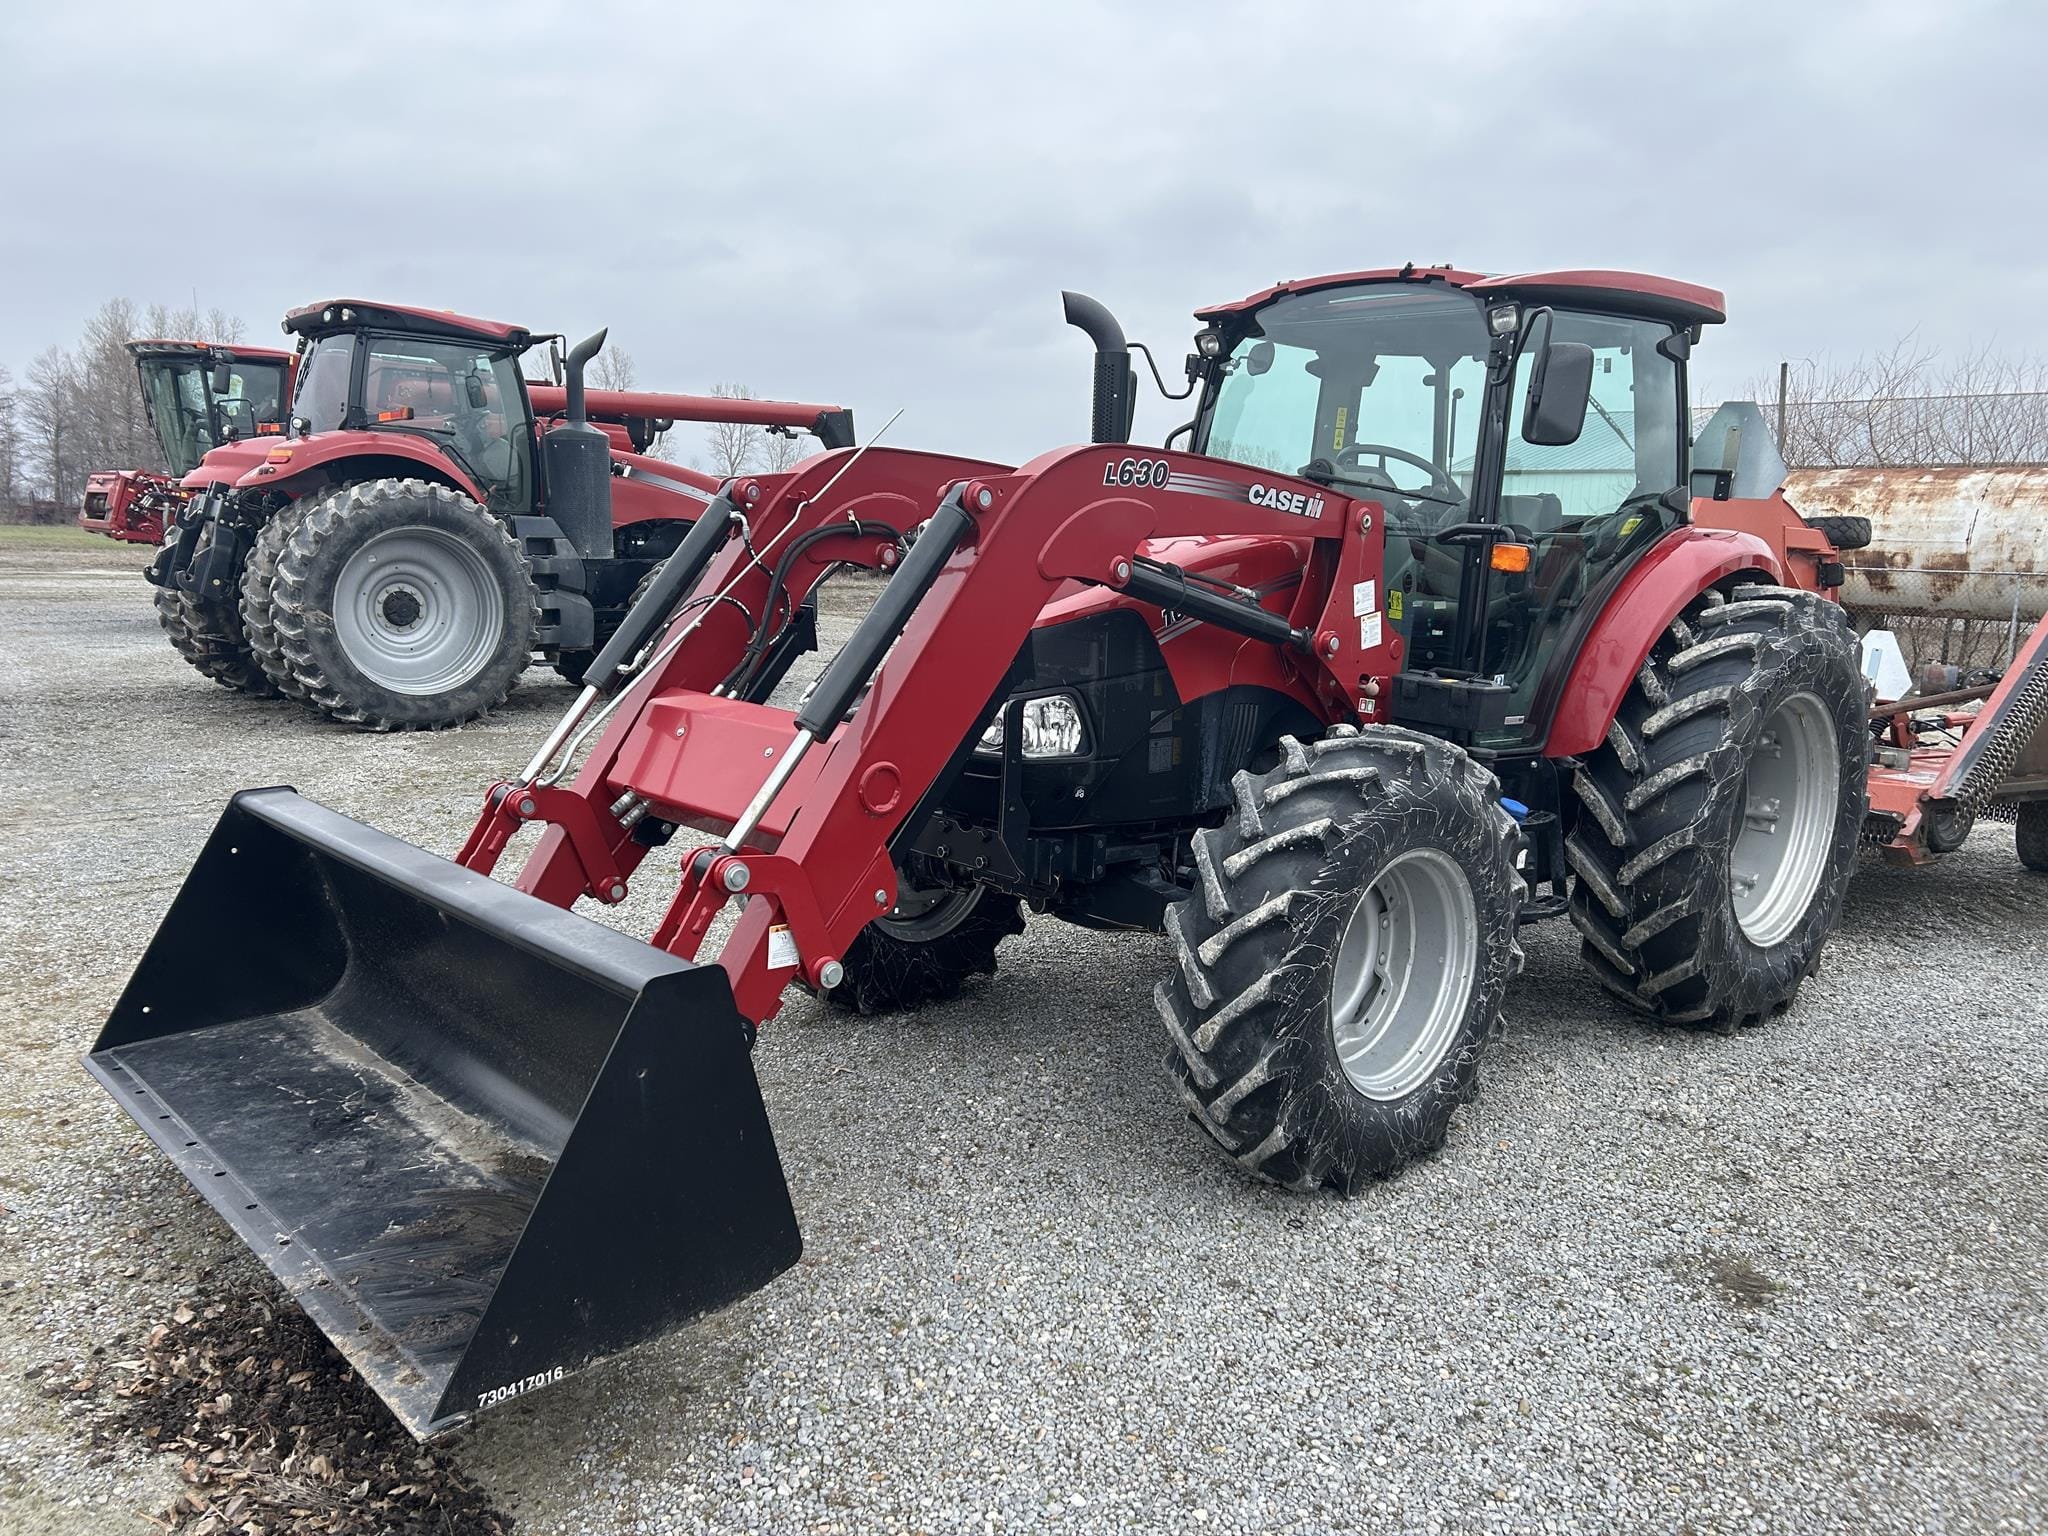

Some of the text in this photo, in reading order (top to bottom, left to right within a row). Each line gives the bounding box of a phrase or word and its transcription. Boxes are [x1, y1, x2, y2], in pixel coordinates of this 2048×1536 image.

[1103, 457, 1169, 488] L630
[1248, 483, 1306, 514] CASE
[477, 1366, 563, 1407] 730417016
